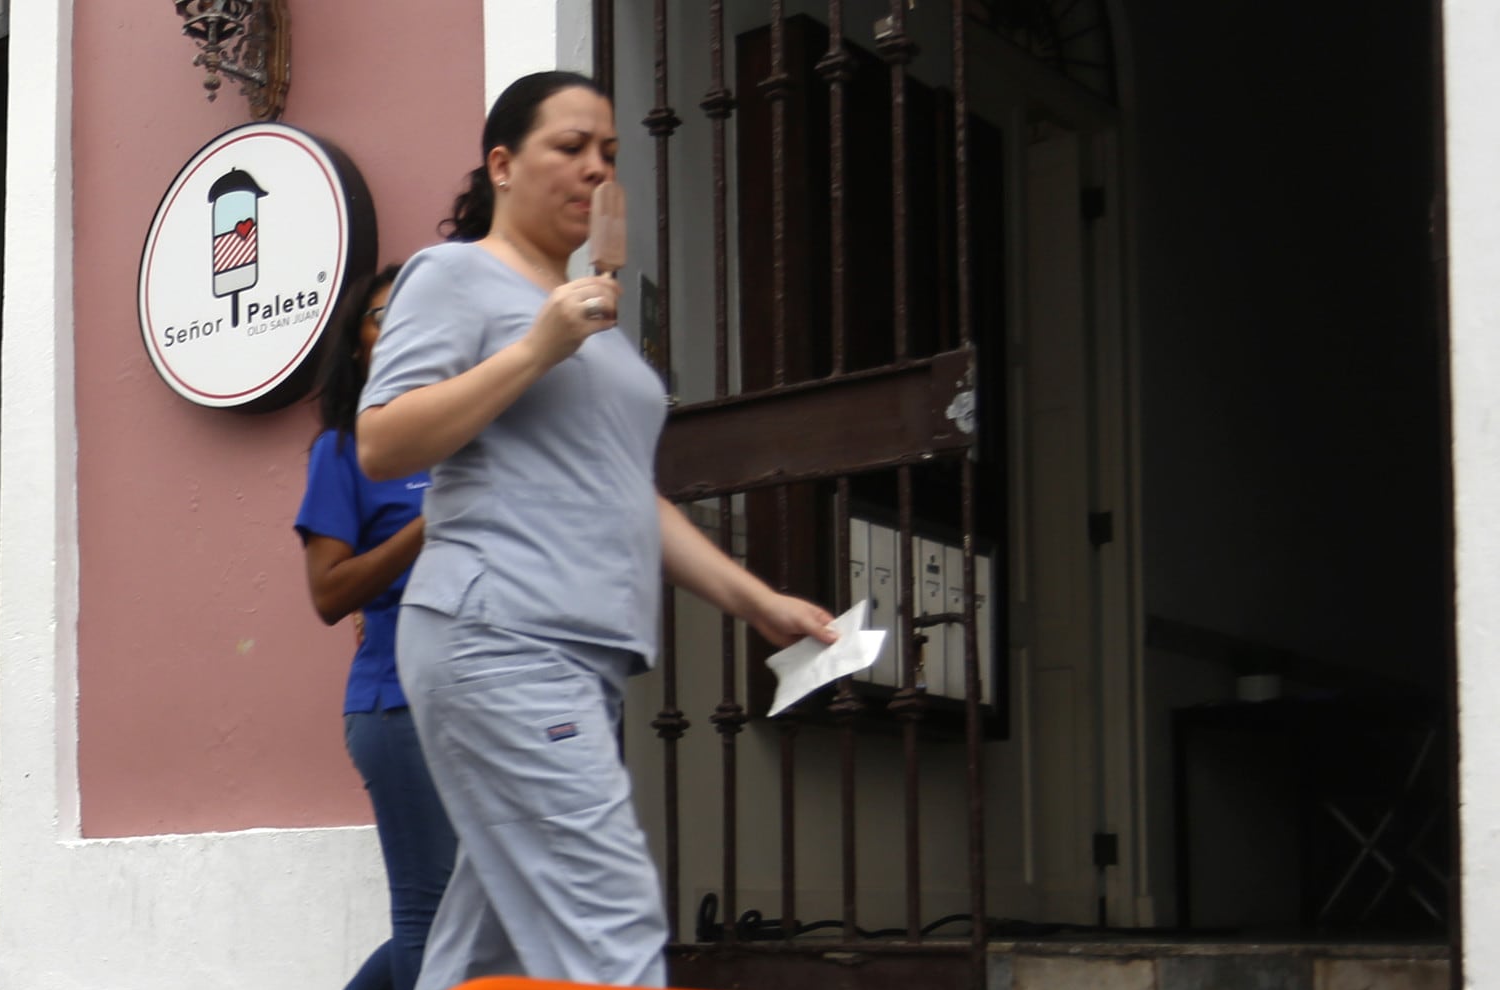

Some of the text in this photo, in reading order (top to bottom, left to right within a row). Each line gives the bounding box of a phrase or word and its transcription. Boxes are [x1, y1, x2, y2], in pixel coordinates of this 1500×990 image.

[164, 289, 319, 347] Señor Paleta
[247, 308, 320, 336] OLD SAN JUAN
